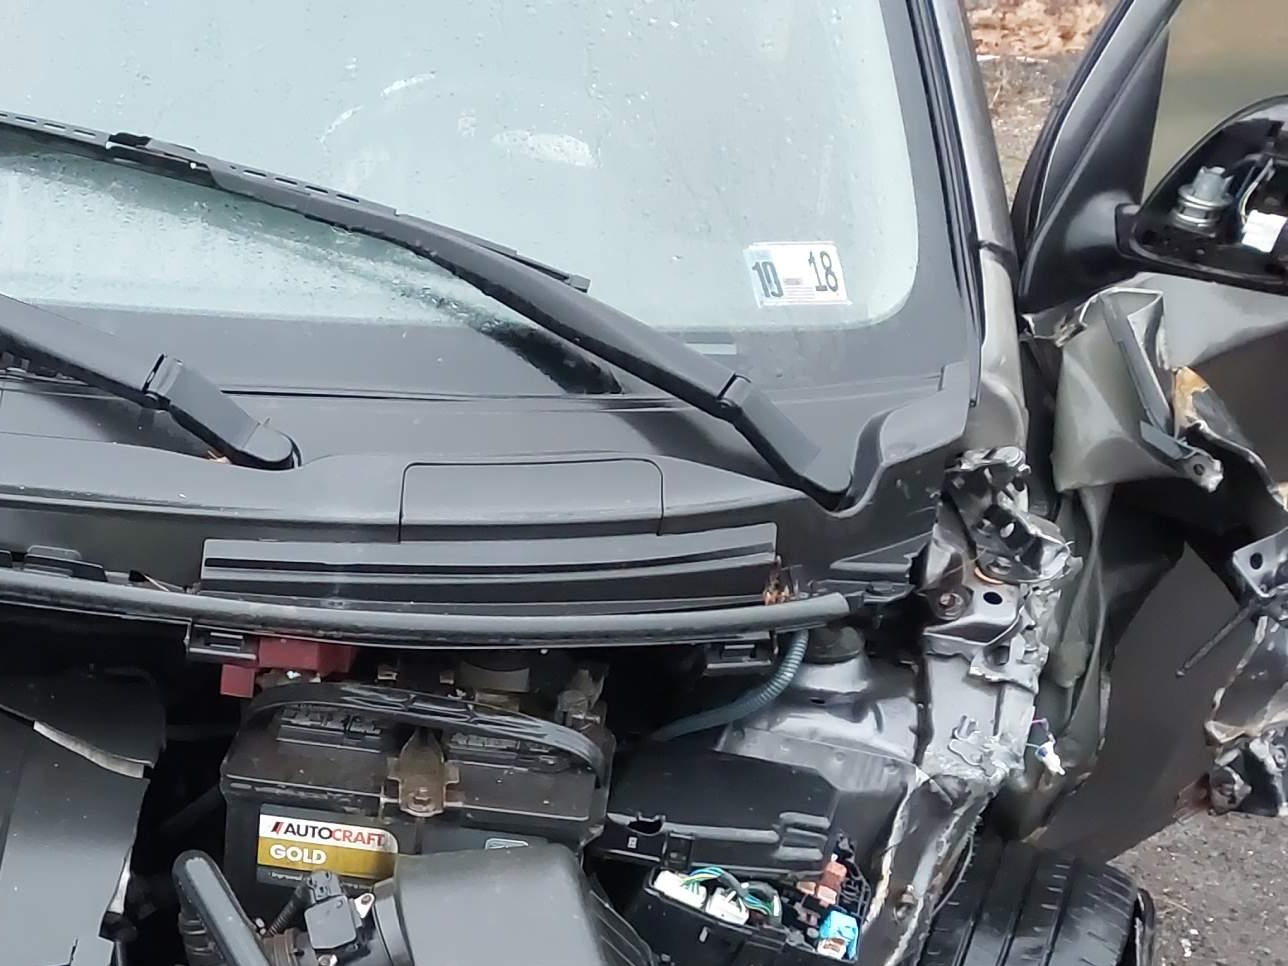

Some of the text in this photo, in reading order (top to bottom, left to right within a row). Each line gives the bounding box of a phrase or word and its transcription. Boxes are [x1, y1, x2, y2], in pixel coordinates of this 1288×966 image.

[752, 261, 784, 298] 10
[808, 250, 839, 292] 18
[283, 822, 385, 847] AUTOCRAFT
[269, 843, 328, 866] GOLD
